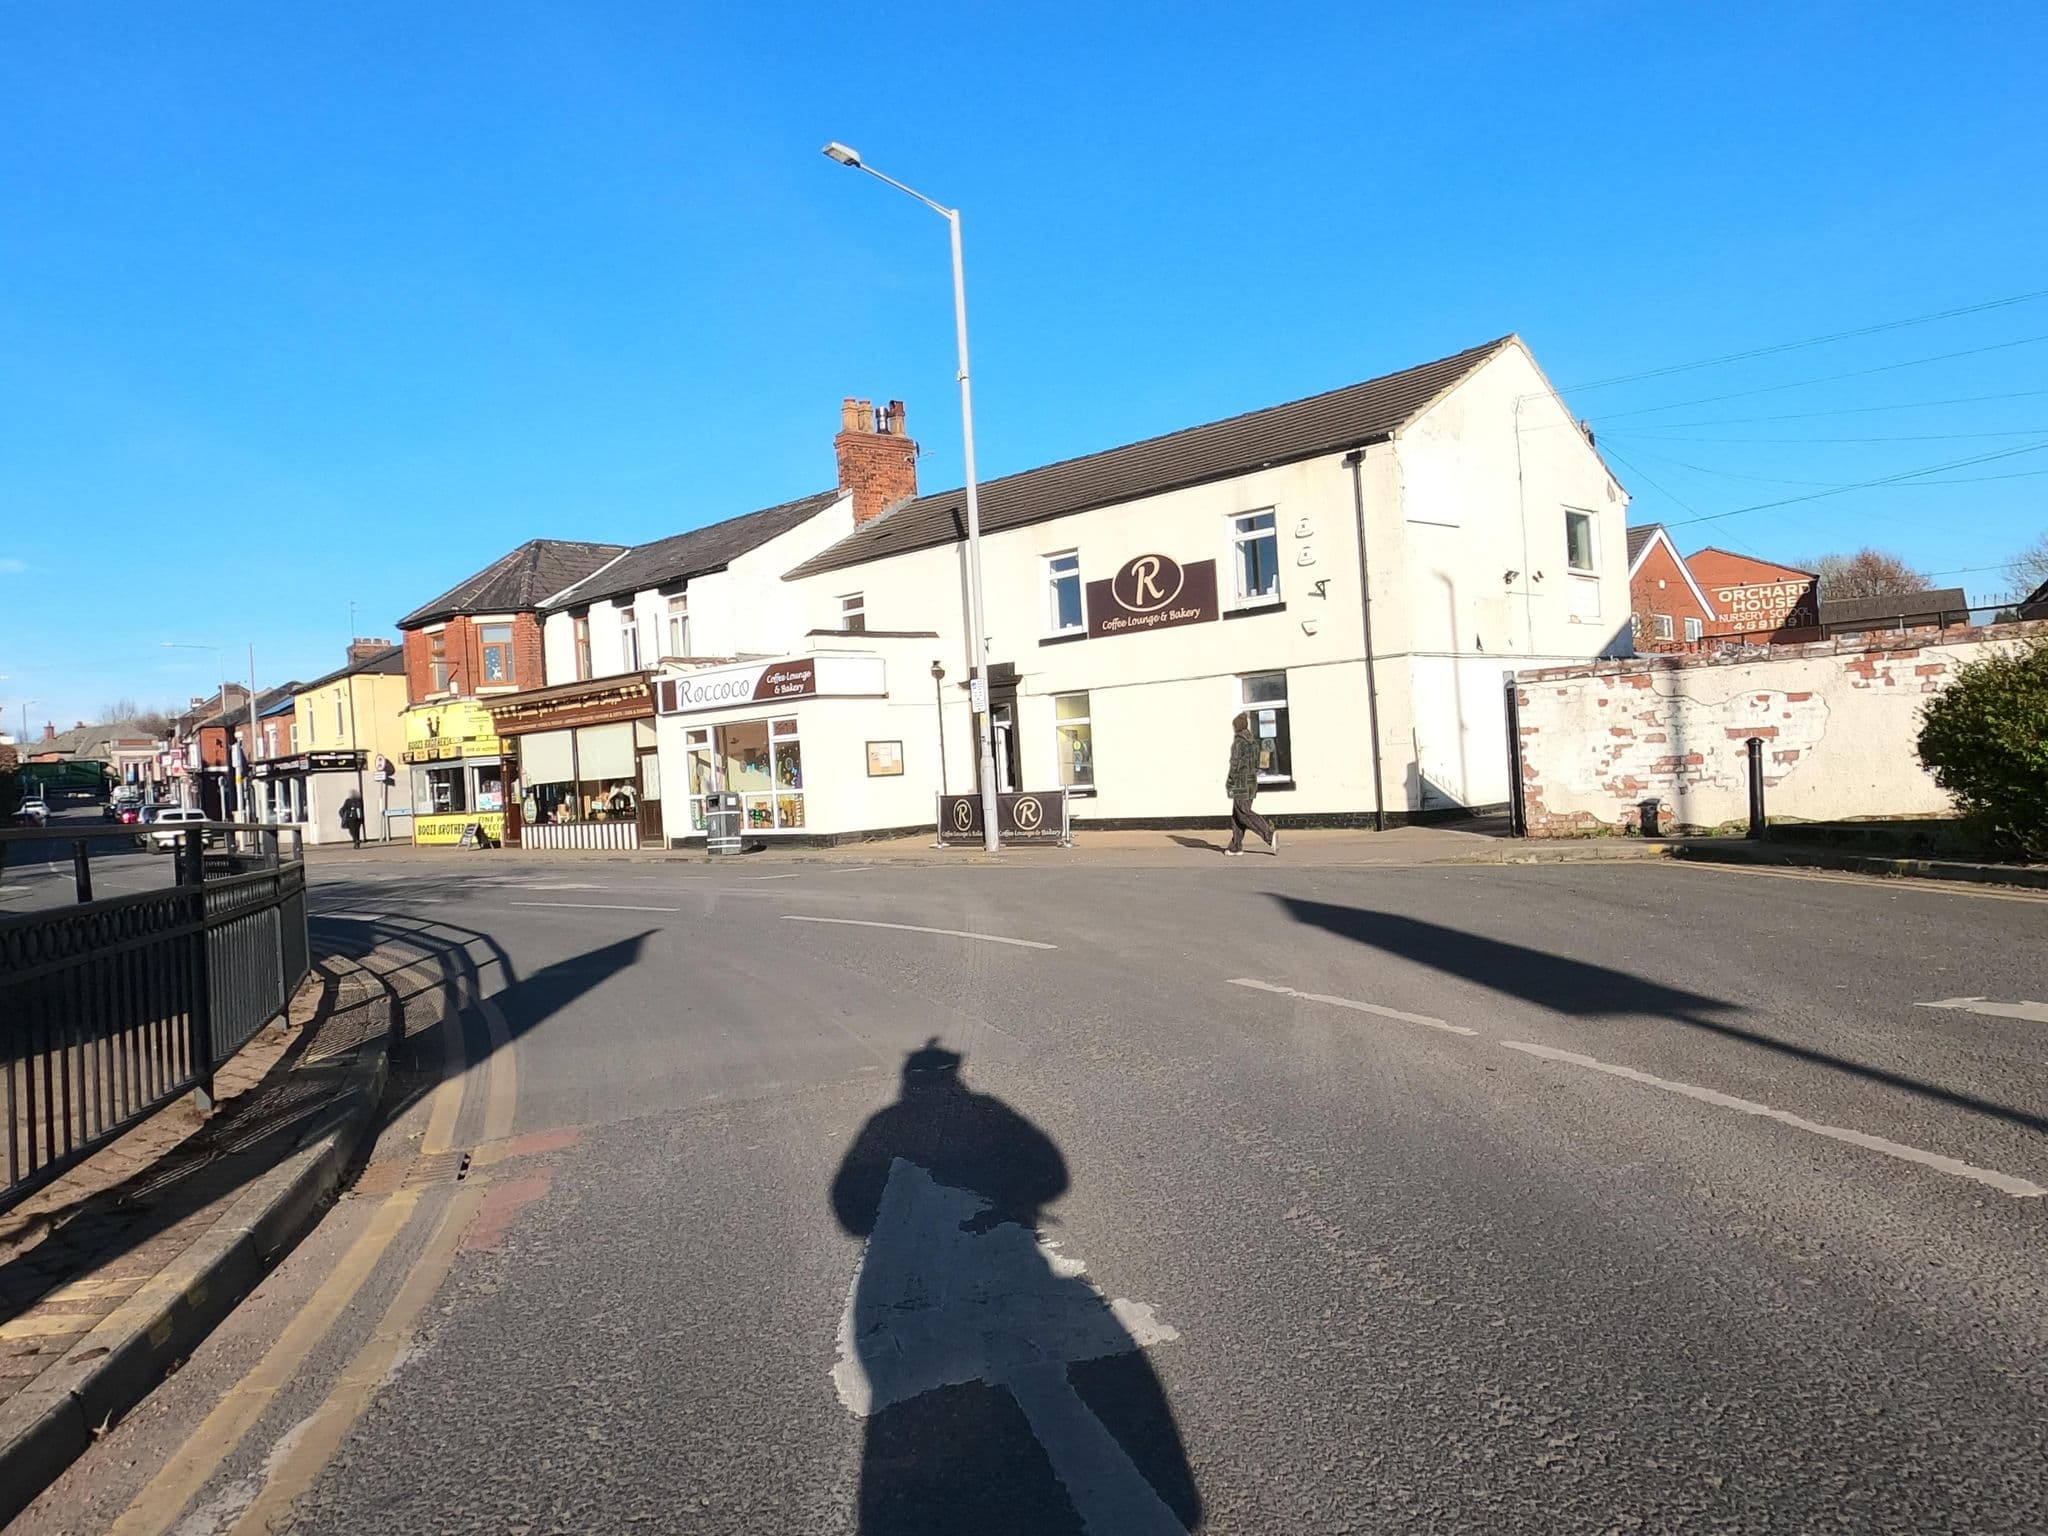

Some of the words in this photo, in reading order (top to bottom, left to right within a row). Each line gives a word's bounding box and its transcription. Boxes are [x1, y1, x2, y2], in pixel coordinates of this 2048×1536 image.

[1131, 556, 1164, 606] R
[1718, 583, 1811, 602] ORCHARD
[1732, 596, 1798, 613] HOUSE
[1102, 616, 1127, 631] Coffee
[1127, 612, 1160, 627] Lounge
[1160, 611, 1168, 622] &
[1169, 607, 1201, 621] Bakery
[1718, 610, 1766, 623] NURSERY
[1769, 607, 1811, 620] SCHOOL
[766, 672, 786, 685] Coffee
[786, 669, 812, 682] Lounge
[774, 685, 781, 694] &
[781, 682, 805, 694] Bakery
[957, 803, 969, 826] R
[1019, 801, 1038, 825] R
[417, 823, 436, 836] BOOZE
